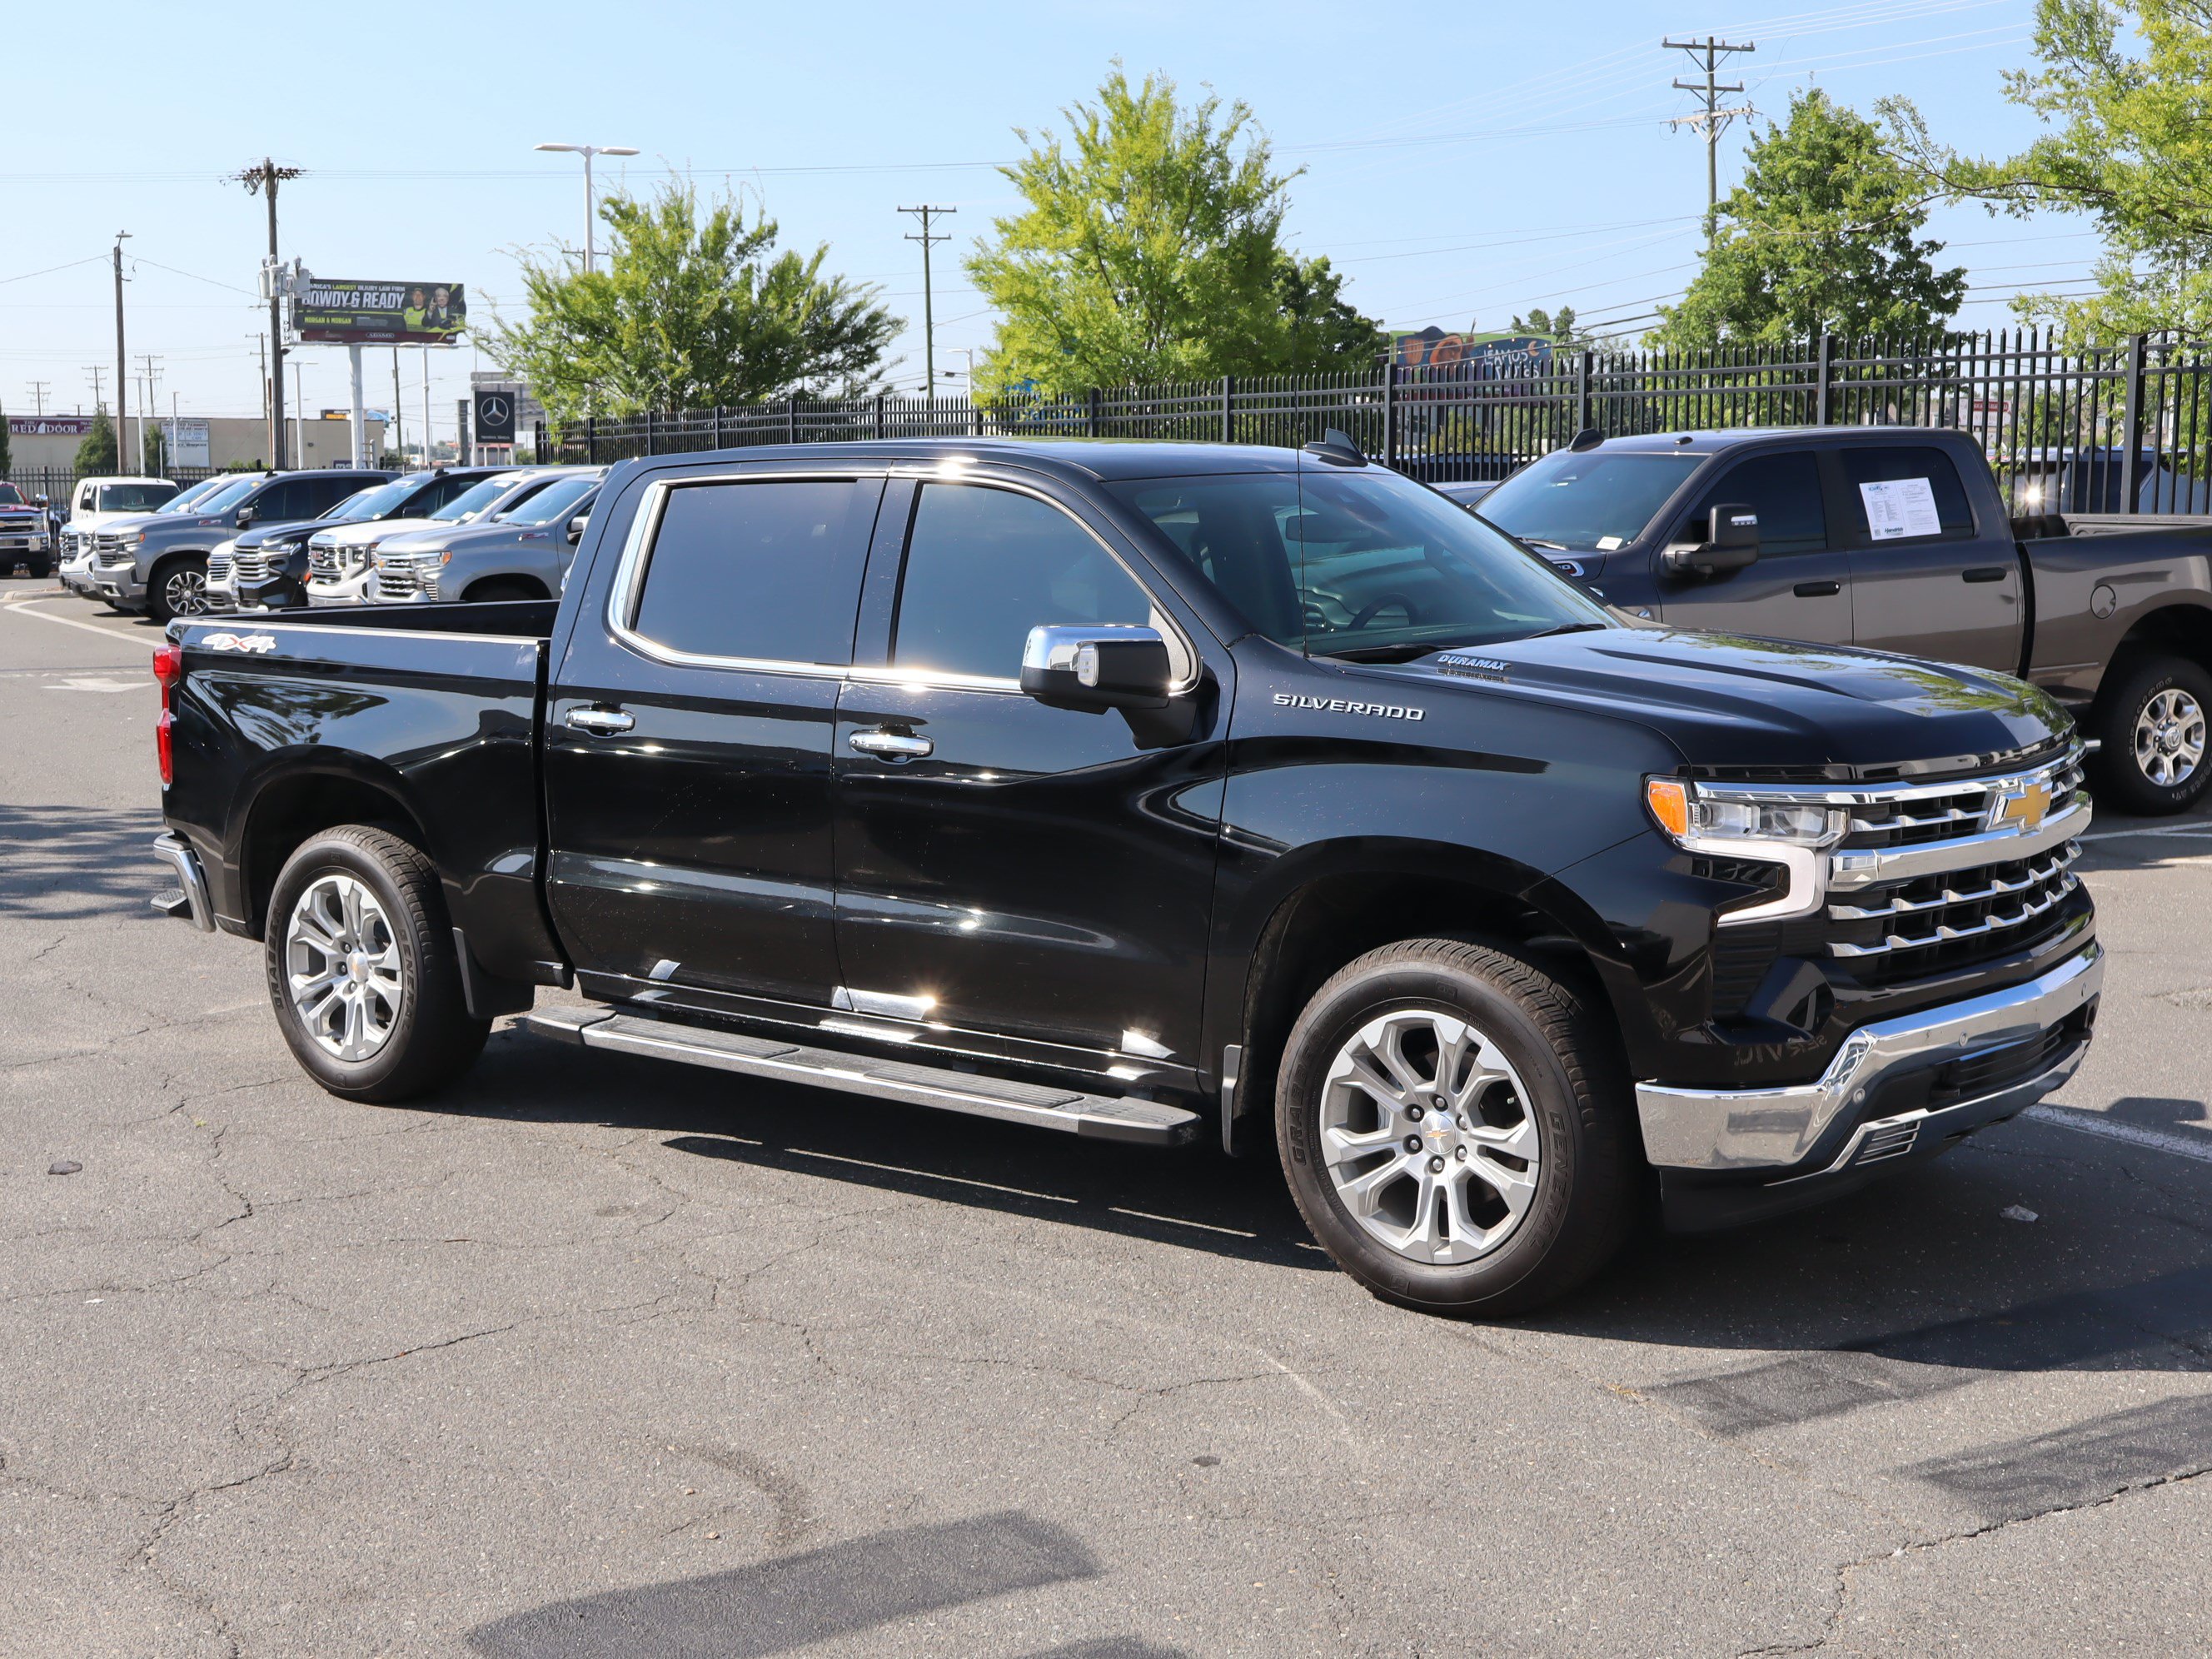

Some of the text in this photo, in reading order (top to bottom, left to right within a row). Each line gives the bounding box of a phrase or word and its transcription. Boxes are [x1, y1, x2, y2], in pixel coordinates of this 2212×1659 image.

[351, 291, 360, 308] &
[362, 291, 406, 309] READY
[331, 316, 352, 325] MORGAN
[11, 424, 37, 434] RED
[47, 423, 77, 434] DOOR
[1437, 655, 1512, 671] DURAMAX
[1273, 693, 1426, 722] SILVERADO
[1528, 1110, 1569, 1249] GENERAL
